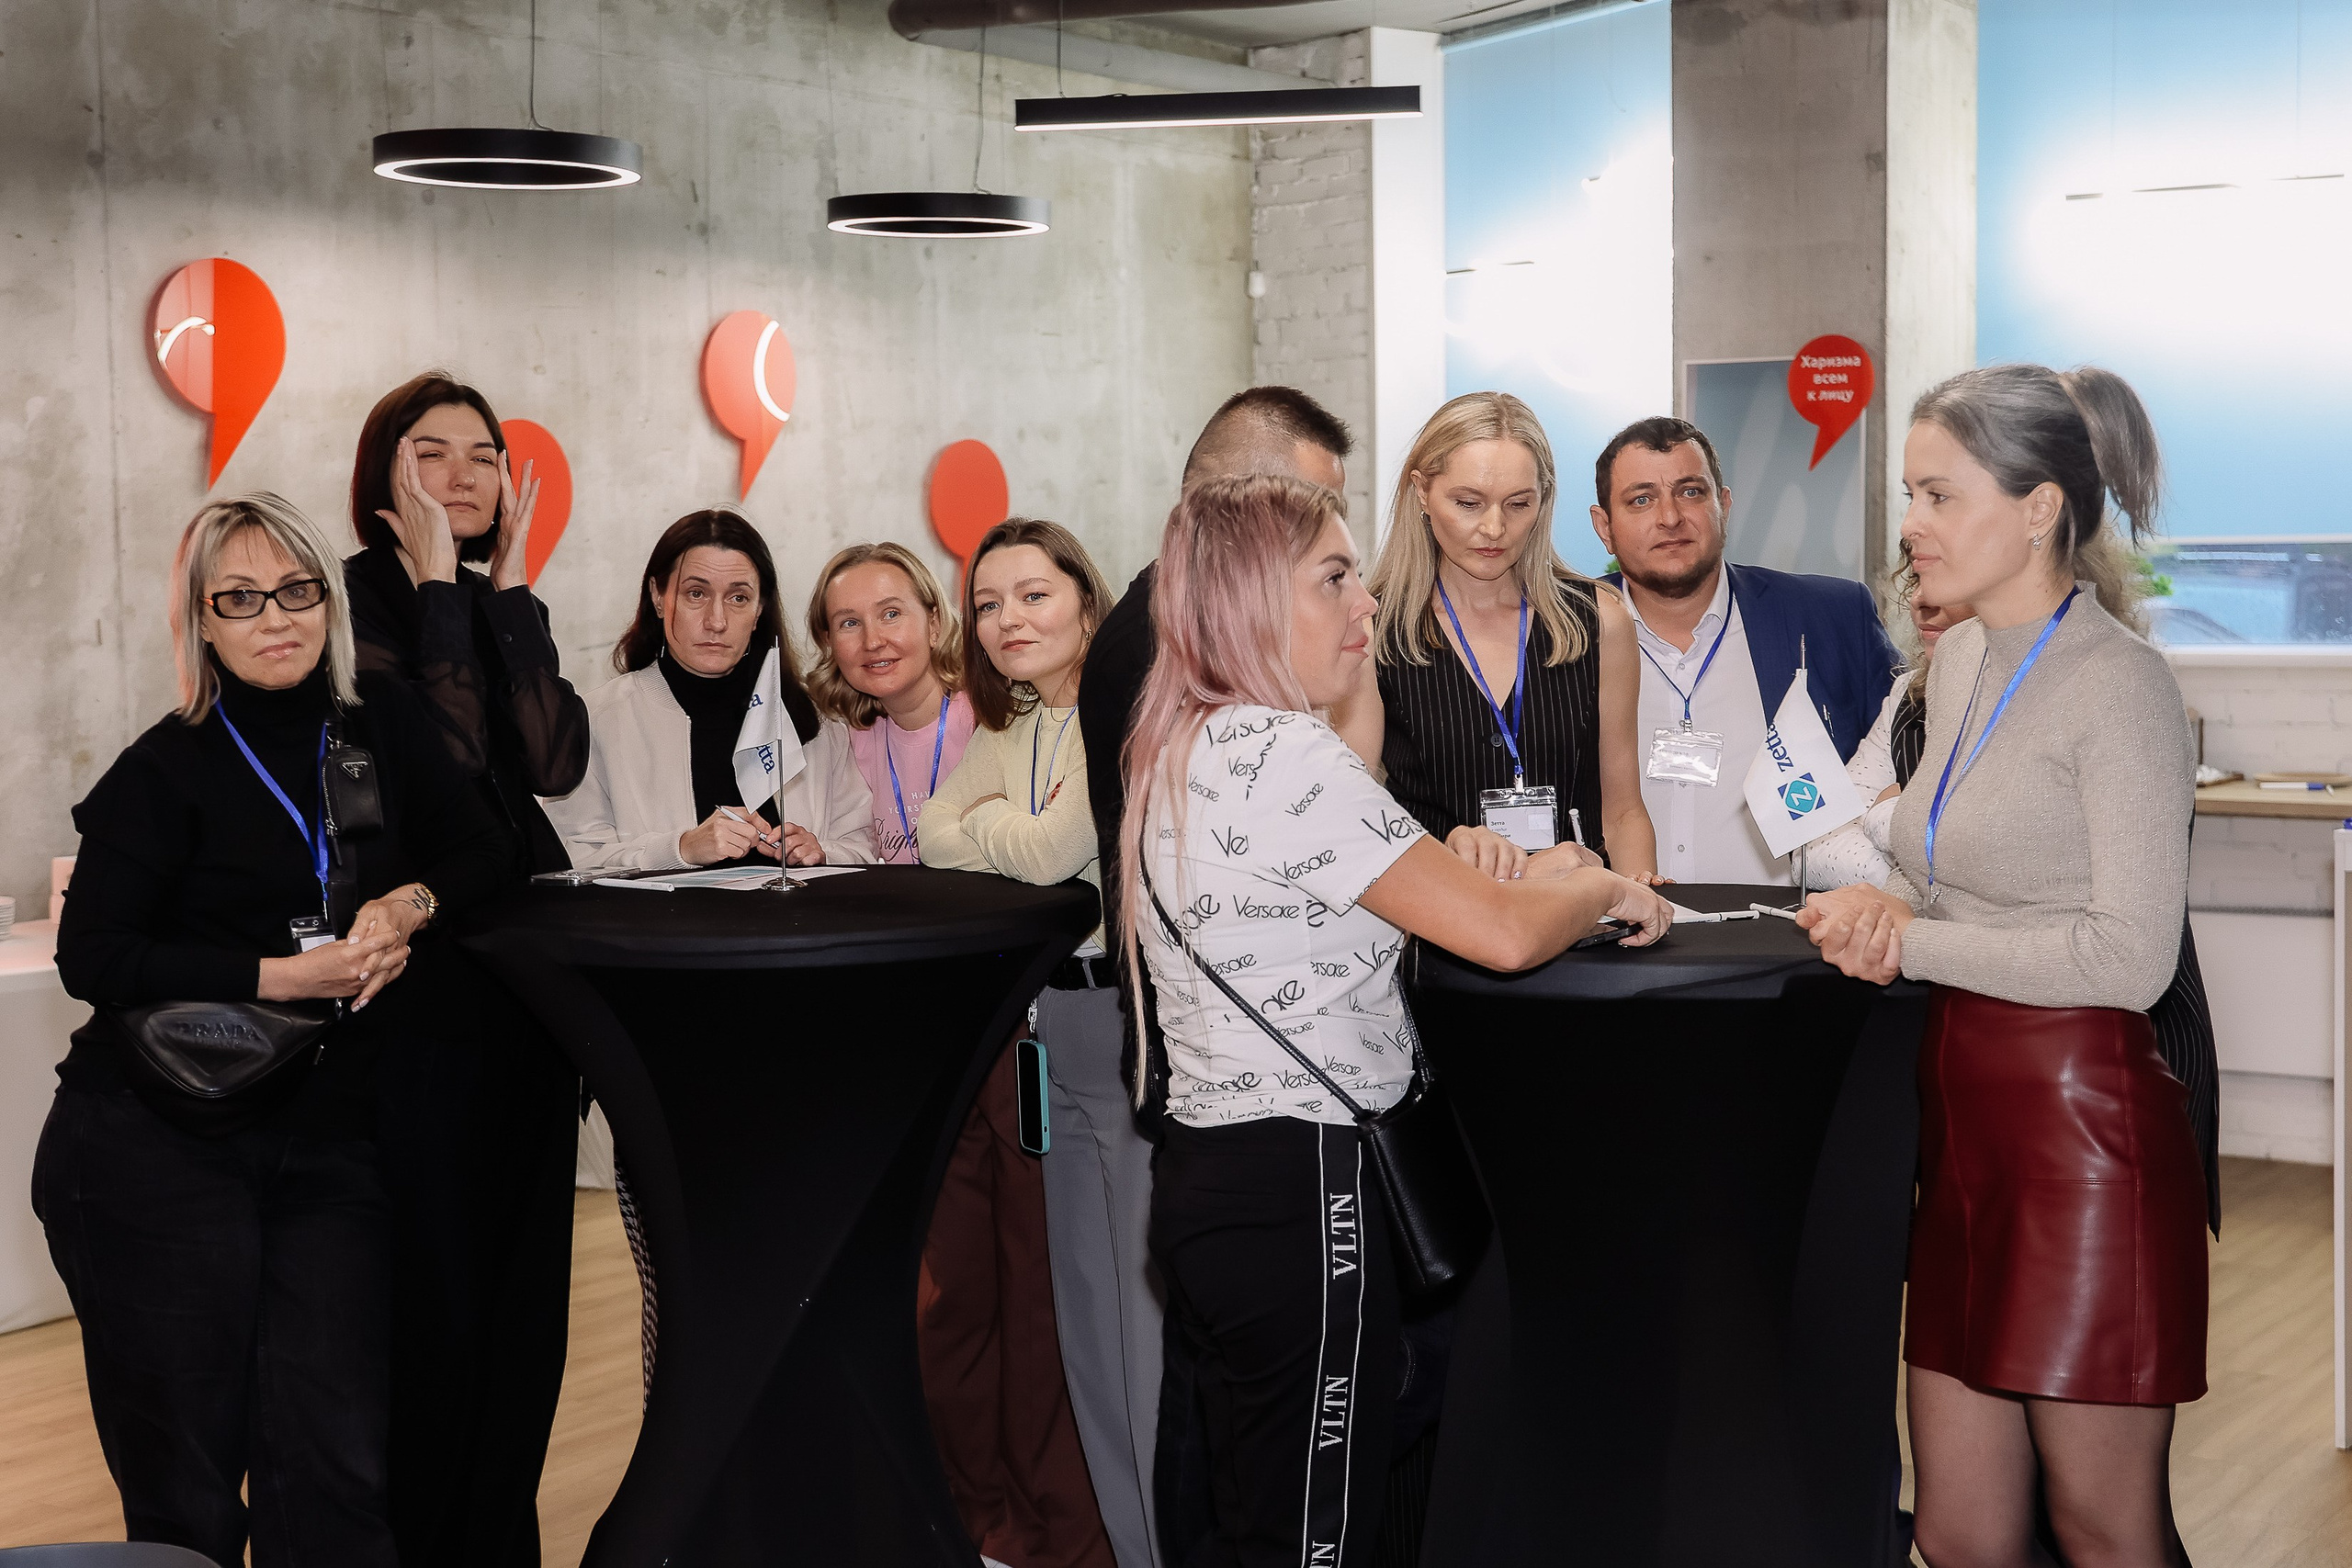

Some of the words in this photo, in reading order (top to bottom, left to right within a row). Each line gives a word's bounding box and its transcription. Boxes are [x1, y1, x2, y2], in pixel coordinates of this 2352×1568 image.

[1801, 355, 1861, 370] Харизма
[1813, 373, 1849, 384] всем
[1806, 390, 1816, 400] к
[1818, 389, 1854, 402] лицу
[1187, 773, 1220, 802] Versace
[1285, 783, 1324, 817] Versace
[1272, 849, 1337, 882] Versace
[1233, 894, 1300, 919] Versace
[1324, 1055, 1363, 1076] Versace
[1329, 1192, 1357, 1280] VLTN
[1317, 1374, 1349, 1450] VLTN
